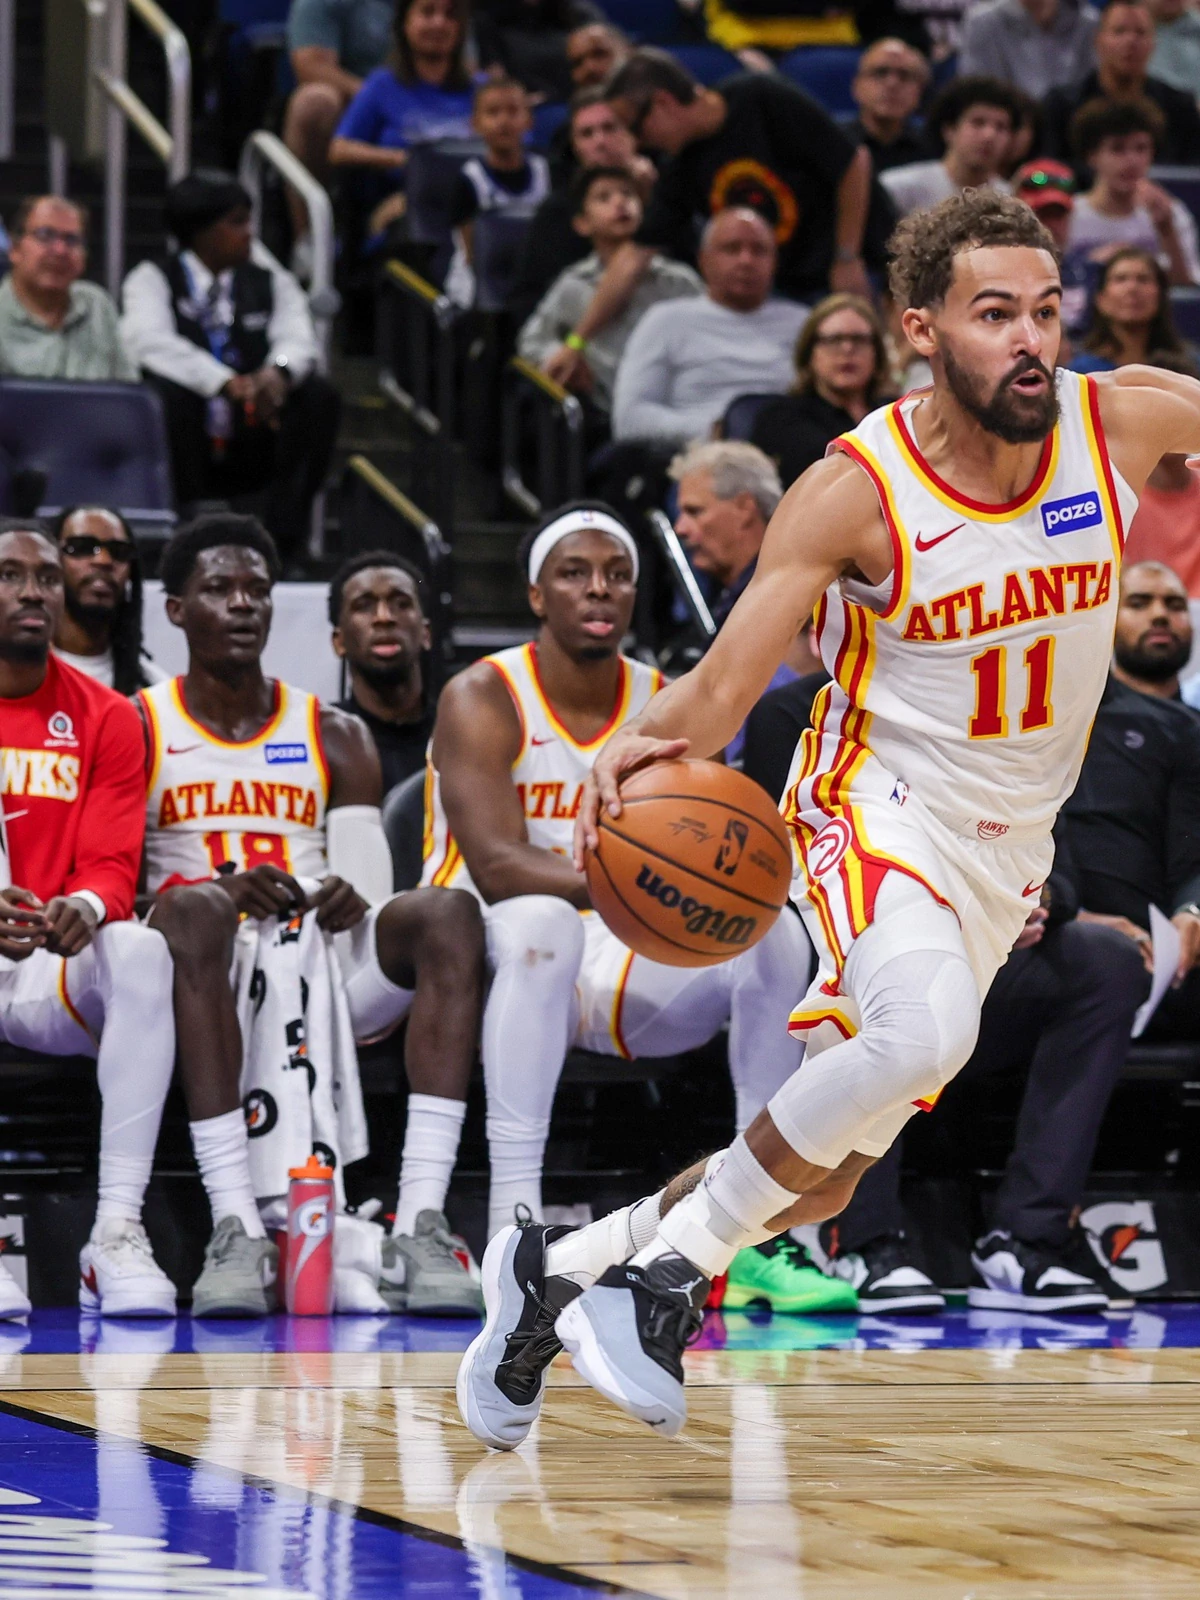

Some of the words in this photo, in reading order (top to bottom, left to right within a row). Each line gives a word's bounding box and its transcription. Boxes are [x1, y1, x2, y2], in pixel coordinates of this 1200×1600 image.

[1045, 500, 1097, 530] paze
[901, 560, 1112, 643] ATLANTA
[968, 634, 1056, 740] 11
[157, 780, 316, 829] ATLANTA
[976, 819, 1010, 836] HAWKS
[635, 863, 757, 945] Wilson
[299, 1203, 328, 1237] G
